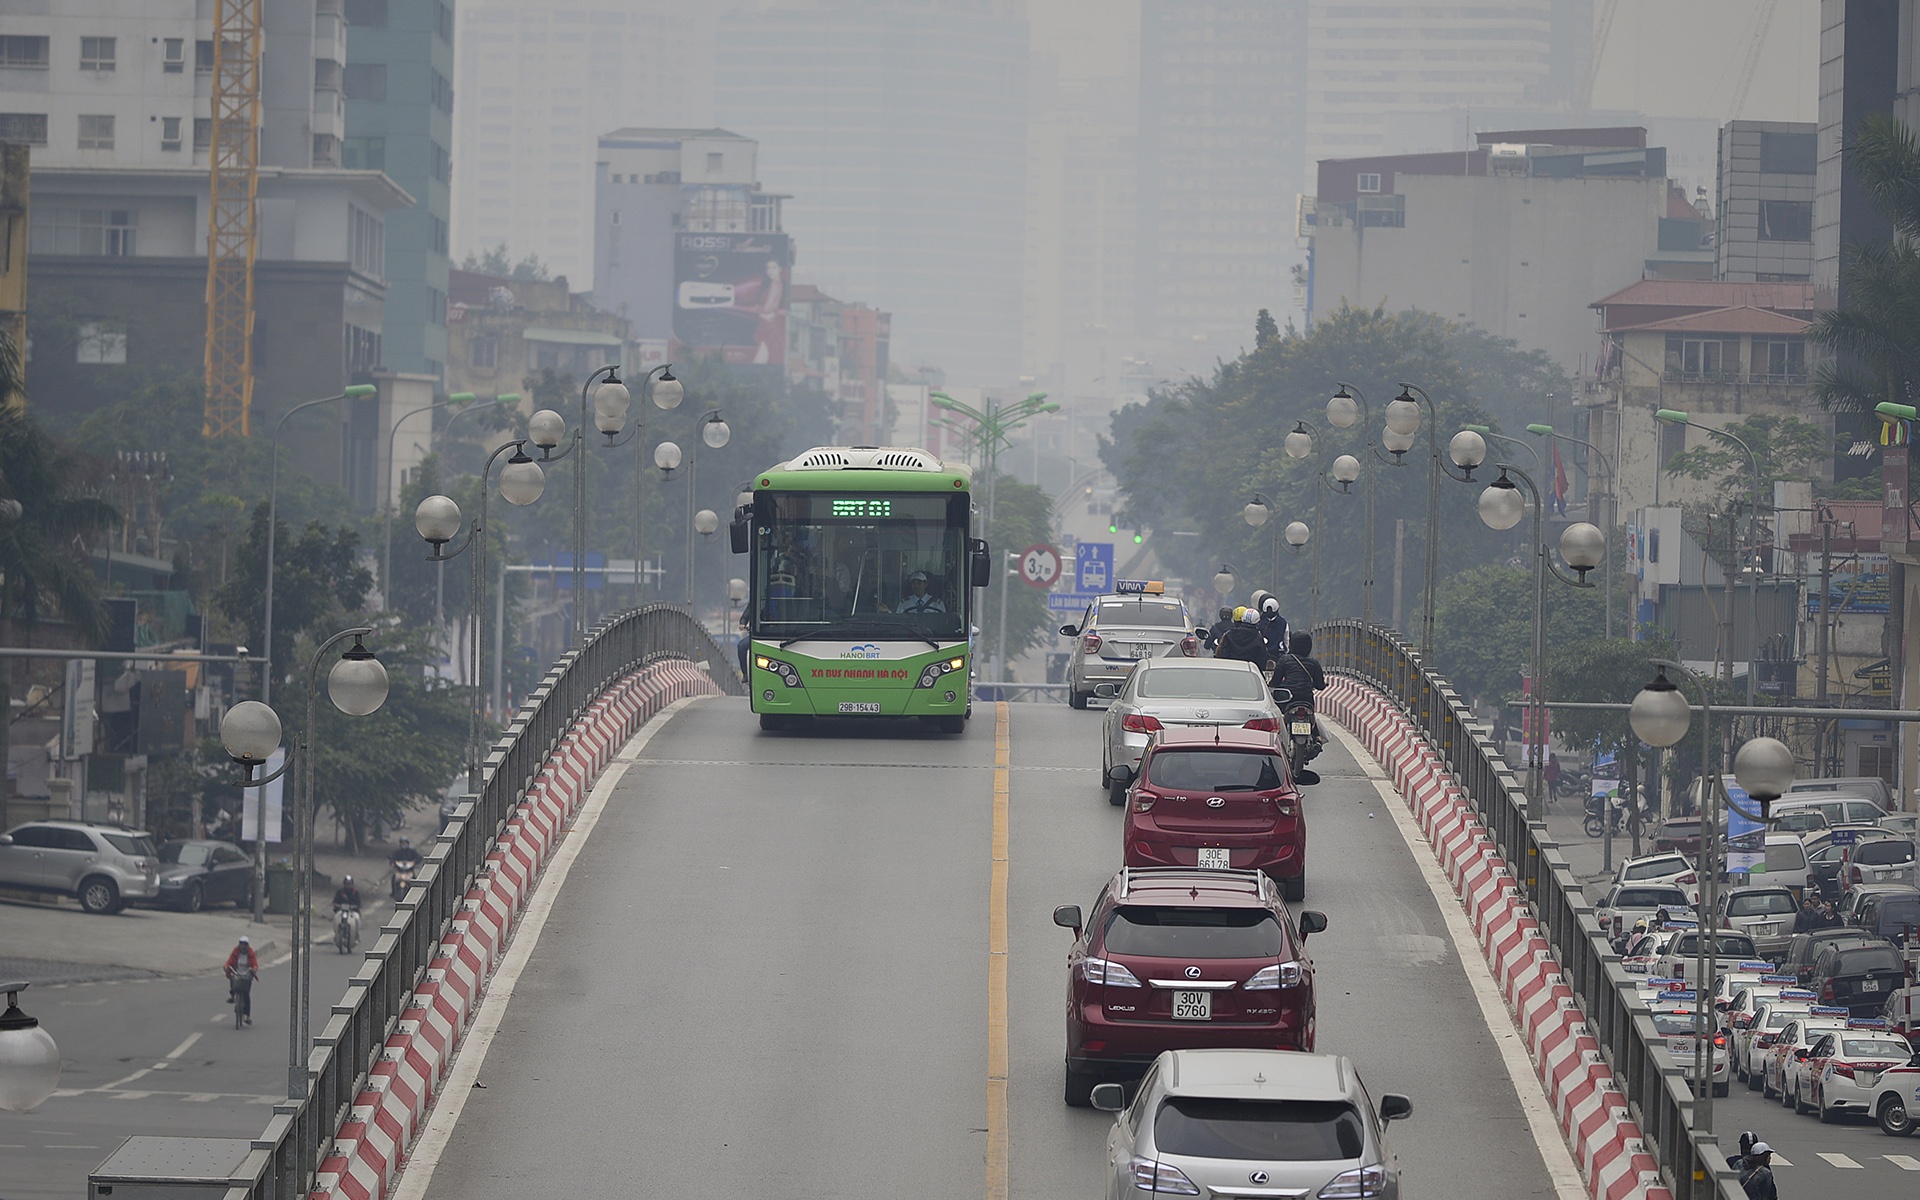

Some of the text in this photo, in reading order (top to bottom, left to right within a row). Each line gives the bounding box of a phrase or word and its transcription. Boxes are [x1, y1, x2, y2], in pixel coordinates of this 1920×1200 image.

[681, 237, 731, 249] ROSSI
[833, 500, 891, 517] BRT 01
[1119, 580, 1142, 591] VINA
[1135, 643, 1148, 651] 30A
[826, 669, 842, 678] BUS
[844, 669, 874, 679] NHANH
[877, 668, 889, 679] HÀ
[891, 668, 908, 680] NỘI
[1206, 849, 1223, 860] 30E
[1181, 993, 1204, 1004] 30V
[1108, 1004, 1136, 1012] LEXUS
[1177, 1005, 1207, 1017] 5760
